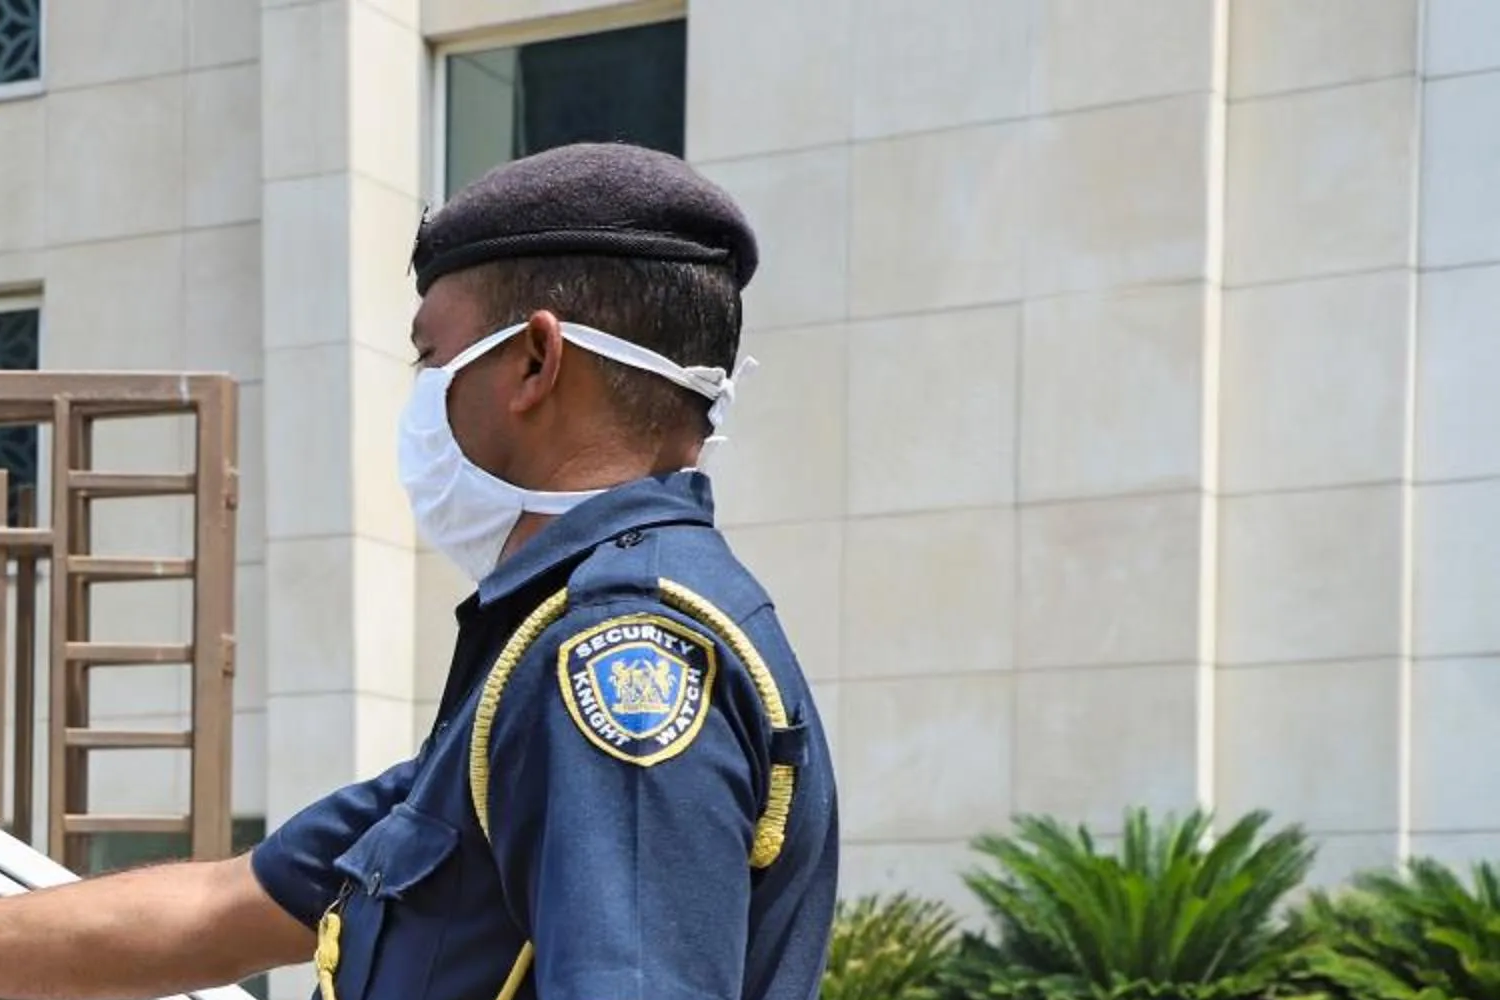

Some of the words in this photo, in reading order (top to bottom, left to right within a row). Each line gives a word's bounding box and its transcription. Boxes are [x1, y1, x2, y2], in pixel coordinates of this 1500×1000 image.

[575, 625, 695, 658] SECURITY
[573, 671, 631, 746] KNIGHT
[656, 668, 701, 745] WATCH
